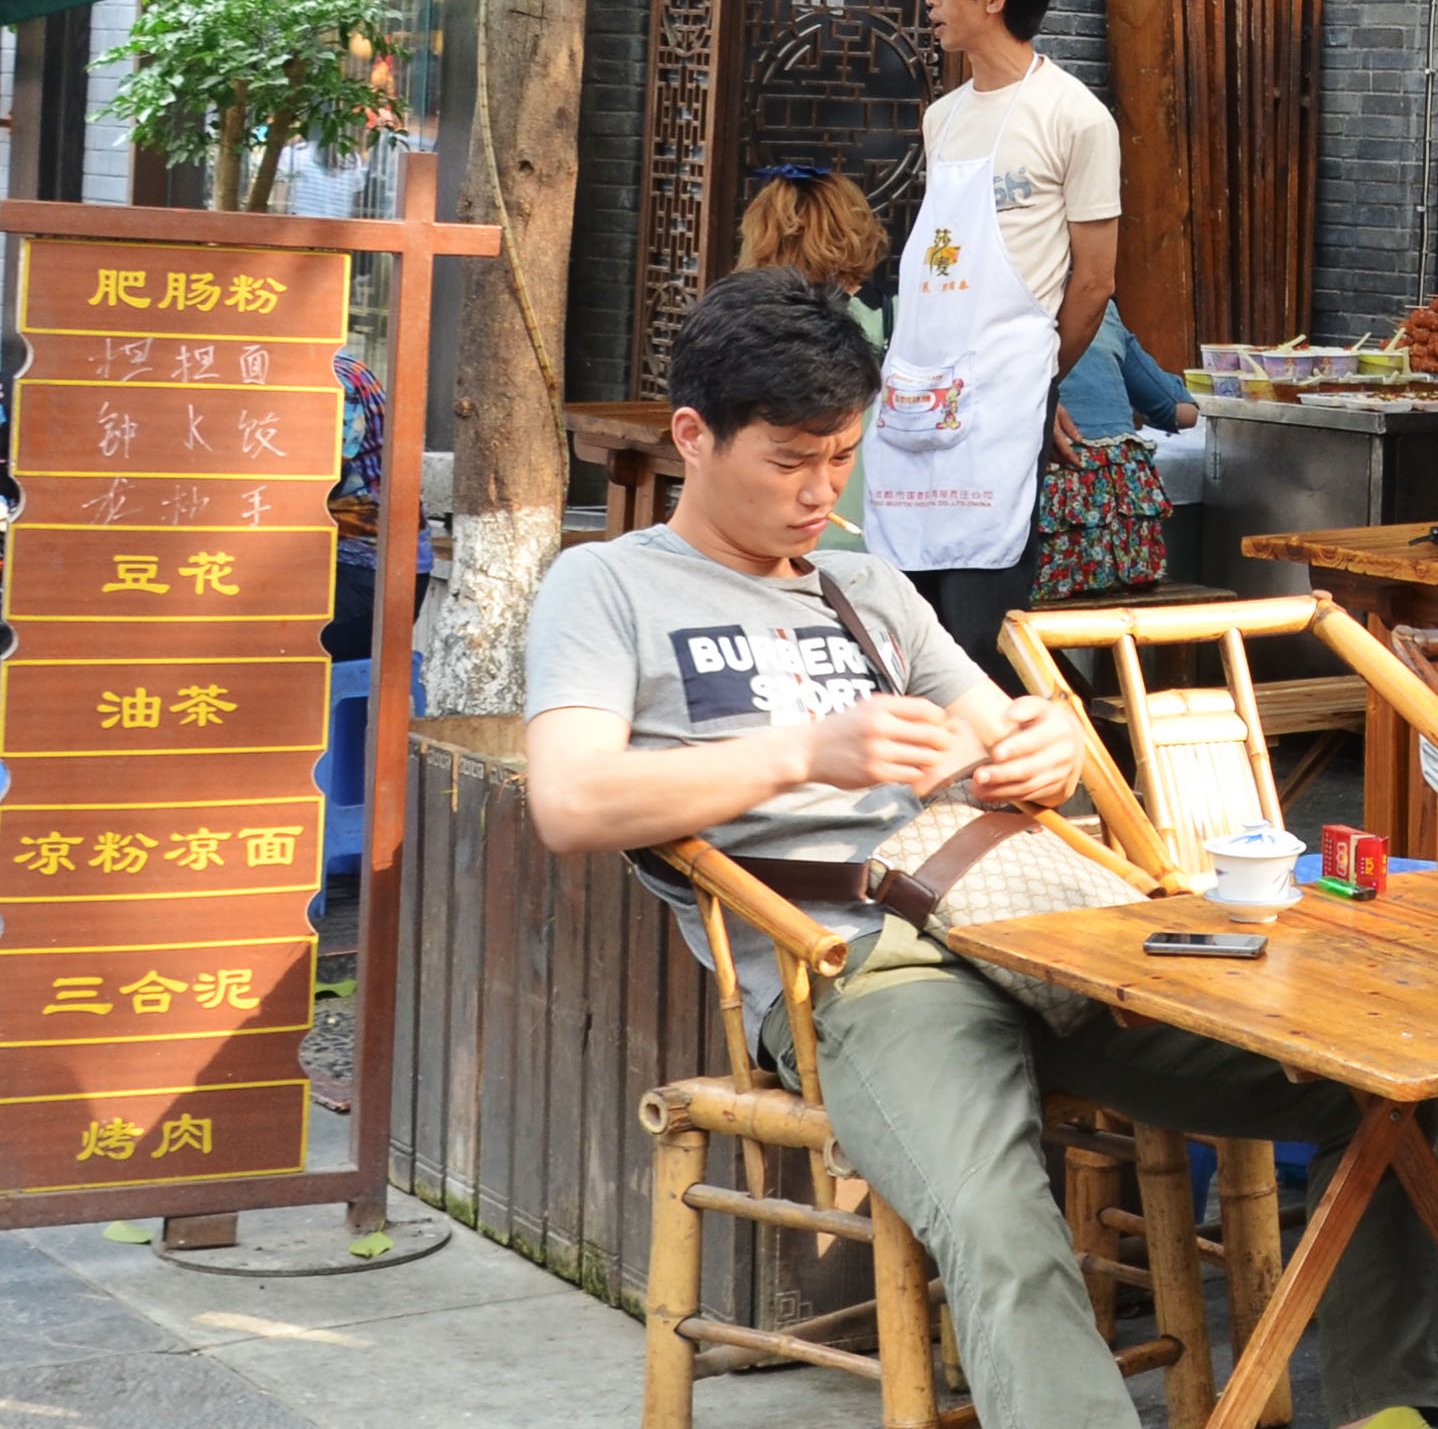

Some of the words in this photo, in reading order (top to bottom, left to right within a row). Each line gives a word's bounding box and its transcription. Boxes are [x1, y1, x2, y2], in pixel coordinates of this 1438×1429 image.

[88, 269, 288, 315] 肥肠粉
[101, 552, 241, 595] 豆花
[96, 684, 239, 729] 油茶
[13, 826, 305, 876] 凉粉凉面
[42, 968, 261, 1016] 三合泥
[76, 1113, 213, 1162] 烤肉
